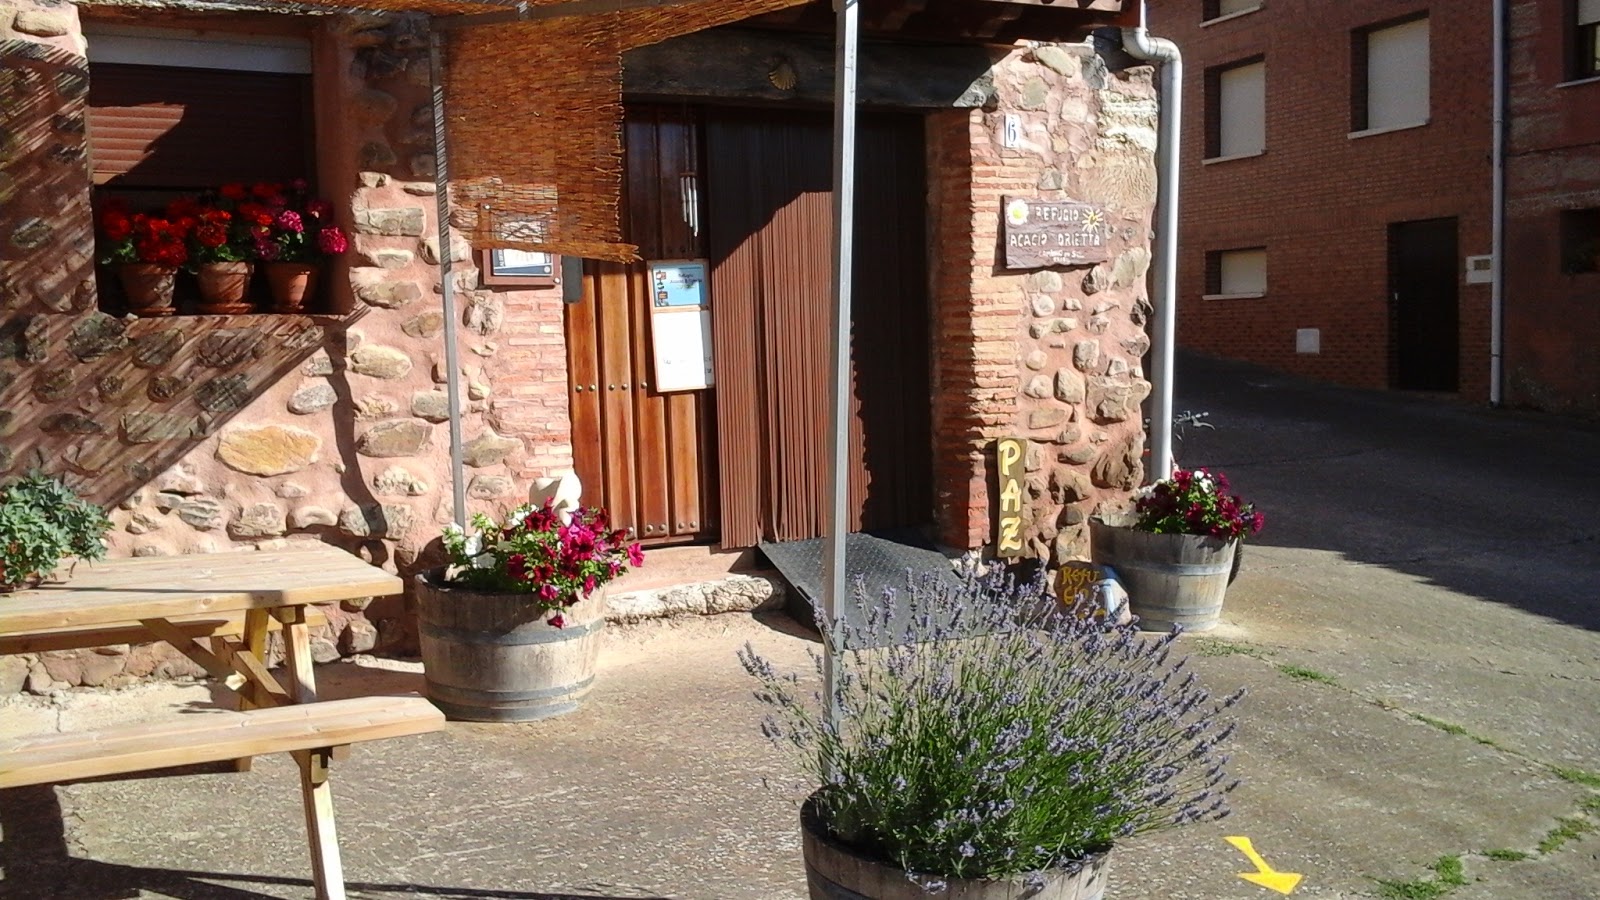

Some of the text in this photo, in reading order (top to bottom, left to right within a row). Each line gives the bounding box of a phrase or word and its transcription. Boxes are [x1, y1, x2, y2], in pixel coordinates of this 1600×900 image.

[1007, 119, 1017, 143] 6
[1035, 206, 1079, 221] REFUGIO
[1010, 232, 1100, 248] ACACIO ORIETTA
[999, 440, 1022, 551] PAZ
